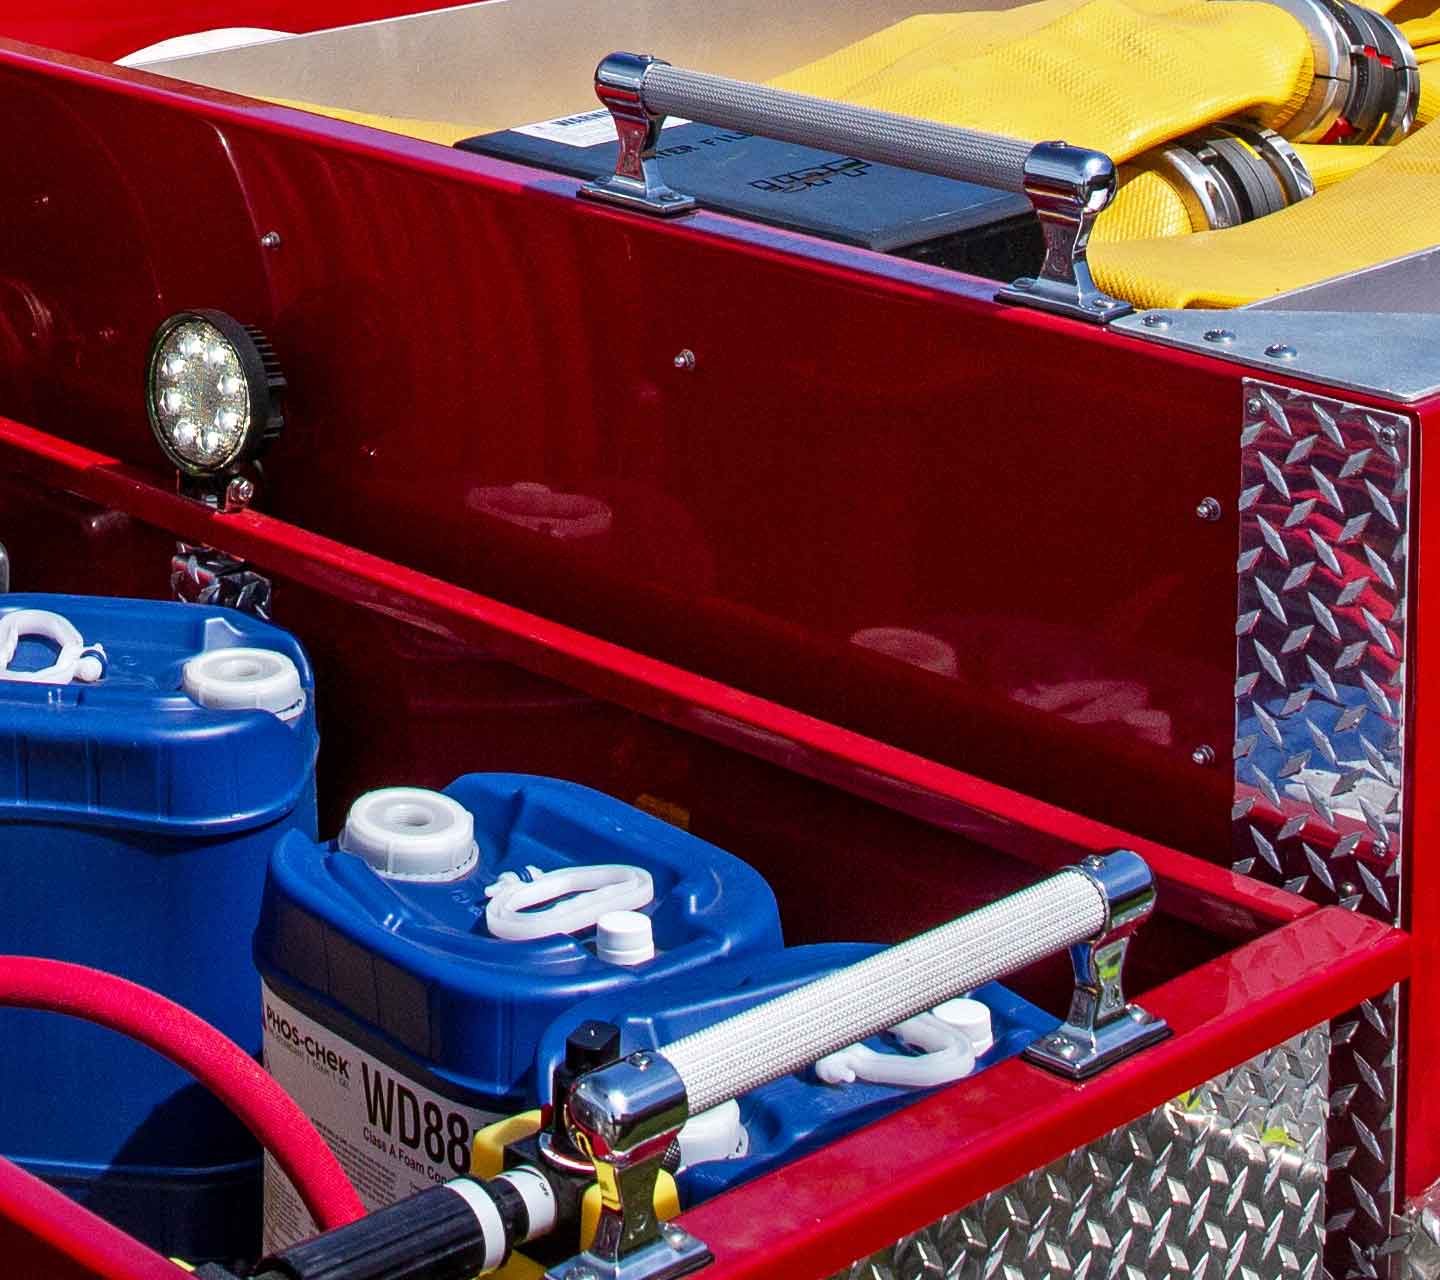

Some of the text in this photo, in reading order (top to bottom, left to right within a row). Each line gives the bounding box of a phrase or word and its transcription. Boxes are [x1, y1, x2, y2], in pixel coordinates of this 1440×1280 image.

[363, 1126, 387, 1154] Class
[389, 1143, 397, 1157] A
[397, 1149, 425, 1176] Foam
